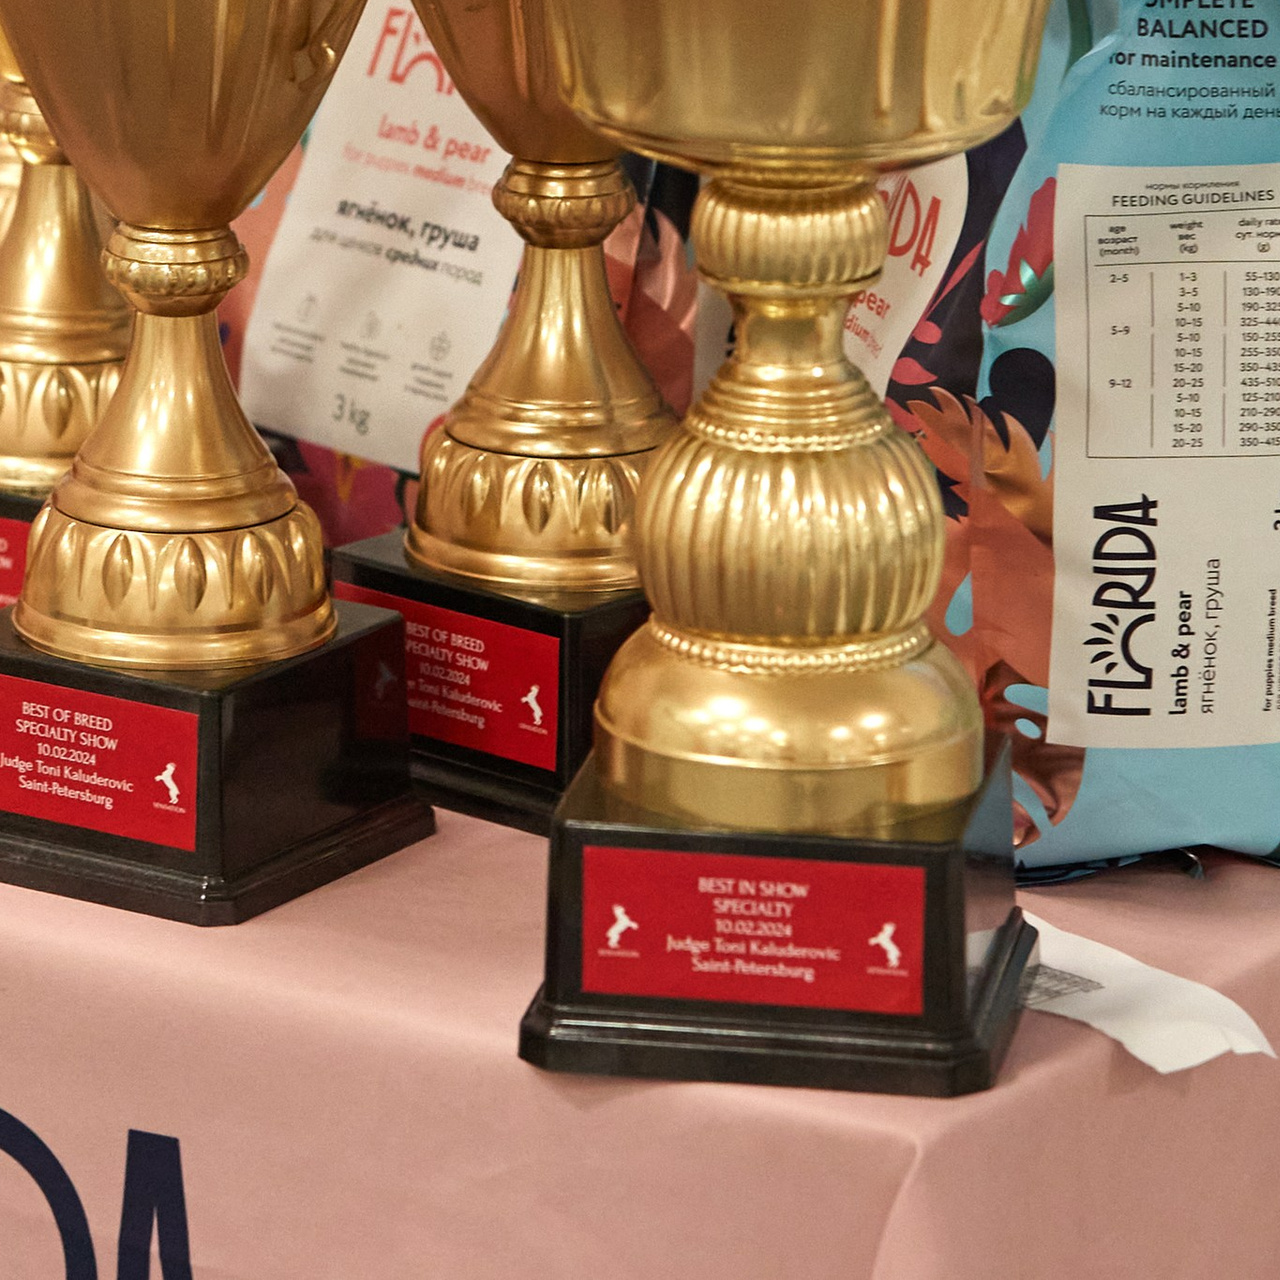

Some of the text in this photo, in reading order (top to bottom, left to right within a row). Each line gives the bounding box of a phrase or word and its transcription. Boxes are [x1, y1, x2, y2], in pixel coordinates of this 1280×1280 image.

[1137, 18, 1268, 39] BALANCED
[1141, 50, 1277, 69] maintenance
[1108, 79, 1276, 101] сбалансированный
[1099, 104, 1141, 120] корм
[1146, 106, 1166, 118] на
[1172, 104, 1238, 120] каждый
[378, 113, 491, 163] lamb & pear
[1145, 180, 1240, 191] нормы кормления
[1111, 190, 1275, 207] FEEDING GUIDELINES
[1108, 225, 1126, 234] age
[1169, 220, 1203, 231] weight
[1238, 218, 1263, 227] daily
[419, 221, 479, 251] груша
[1178, 232, 1196, 241] вес
[1179, 243, 1198, 254] (kg)
[1099, 246, 1140, 257] (month)
[844, 314, 870, 342] dium
[331, 393, 370, 436] 3 kg
[1082, 493, 1158, 716] FLORIDA
[406, 621, 486, 653] BEST OF BREED
[1197, 558, 1224, 714] ягнёнок, груша
[406, 639, 490, 671] PECIALTY SHOW
[1168, 591, 1196, 715] lamb & pear
[1262, 588, 1277, 712] for puppies medium breed
[420, 662, 471, 686] 10.02.2024
[22, 701, 113, 732] BEST OF BREED
[407, 699, 486, 729] aint-Petersburg
[16, 719, 118, 751] SPECIALTY SHOW
[37, 742, 96, 766] 10.02.2024
[0, 752, 134, 793] Judge Toni Kaluderovic
[19, 775, 114, 810] Saint-Petersburg
[698, 876, 810, 899] BEST IN SHOW
[713, 897, 794, 918] SPECIALTY
[715, 919, 792, 938] 10.02.2024
[667, 935, 841, 962] Judge Toni Kaluderovic
[692, 956, 815, 983] Saint-Petersburg
